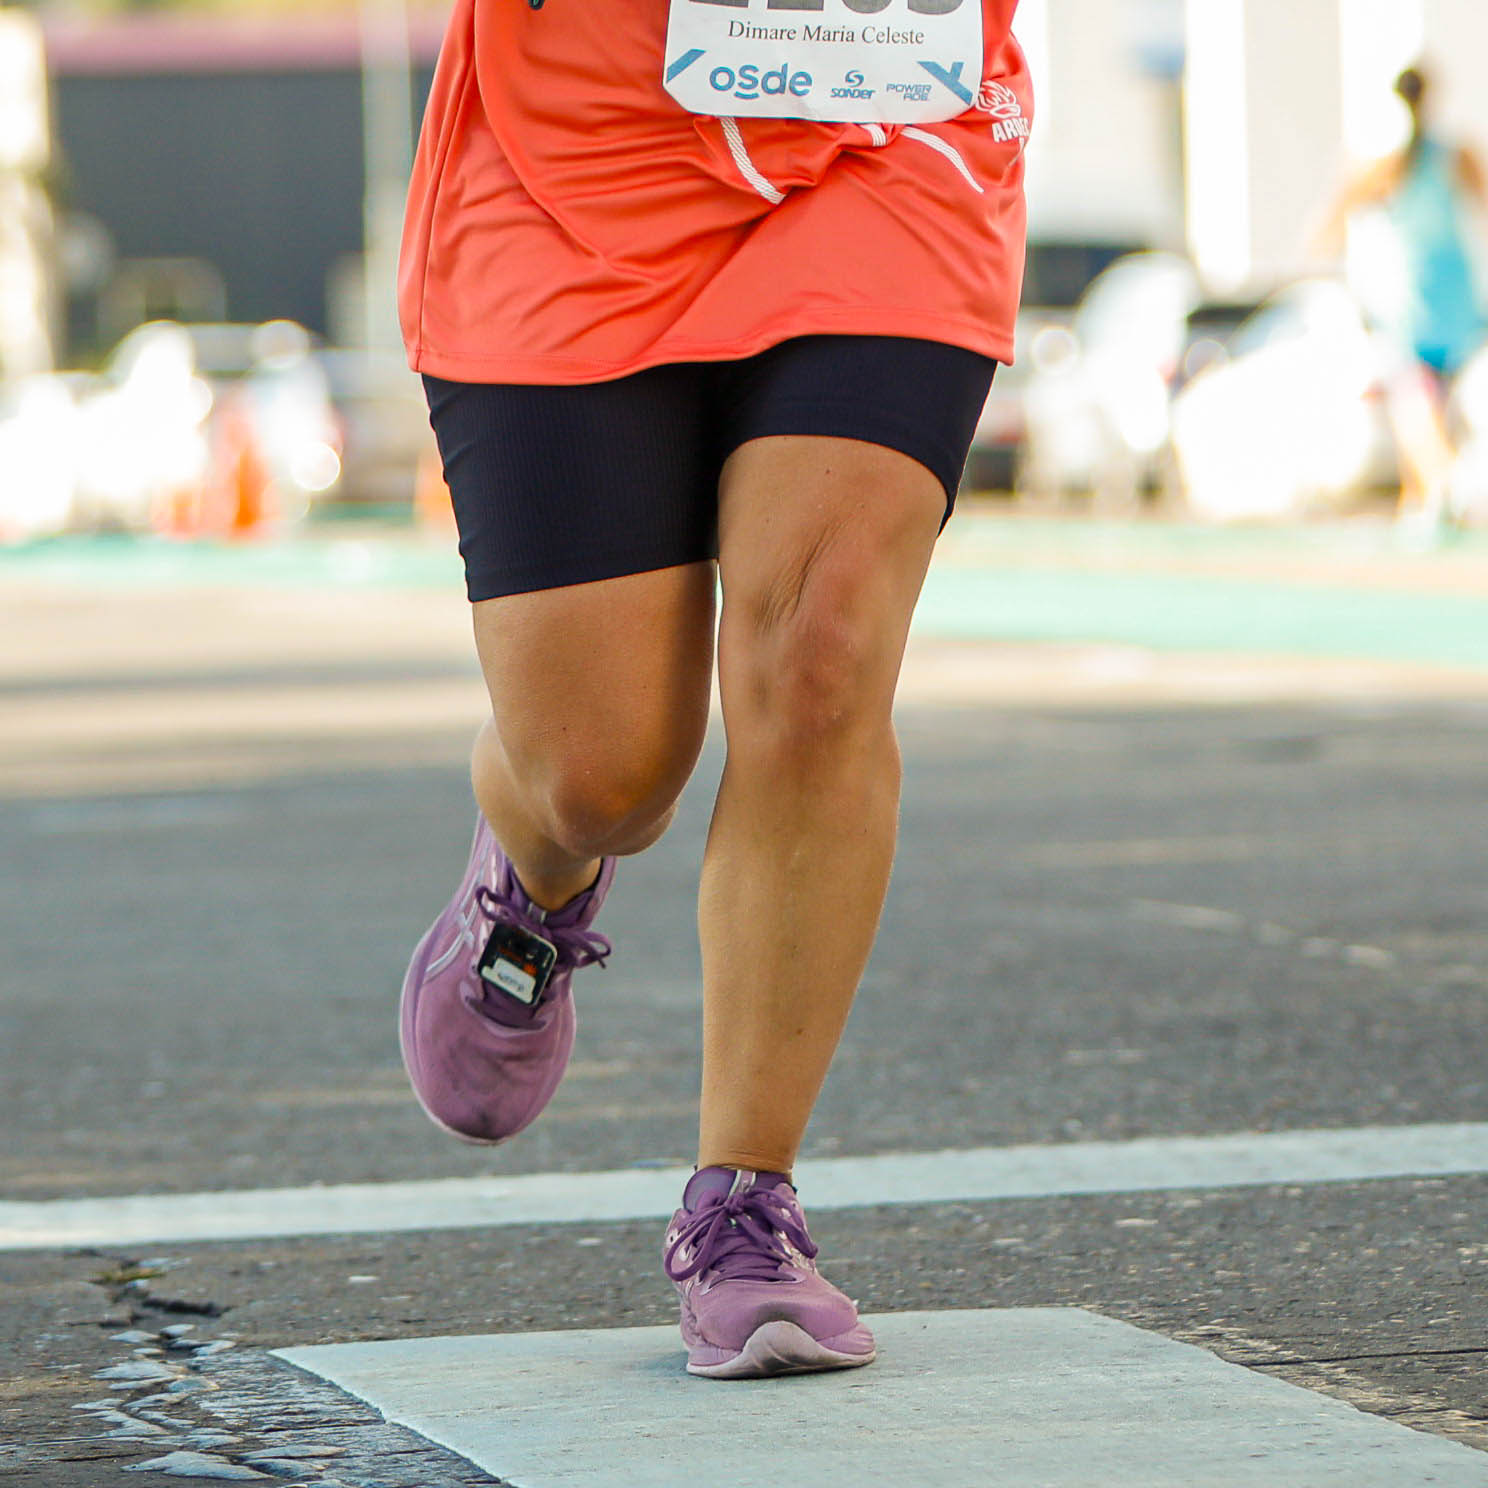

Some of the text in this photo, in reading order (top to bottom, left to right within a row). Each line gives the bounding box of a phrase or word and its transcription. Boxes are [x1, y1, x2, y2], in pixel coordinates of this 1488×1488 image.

[728, 20, 925, 45] Dimare Maria Celeste
[710, 63, 813, 97] osde
[886, 83, 932, 93] POWER
